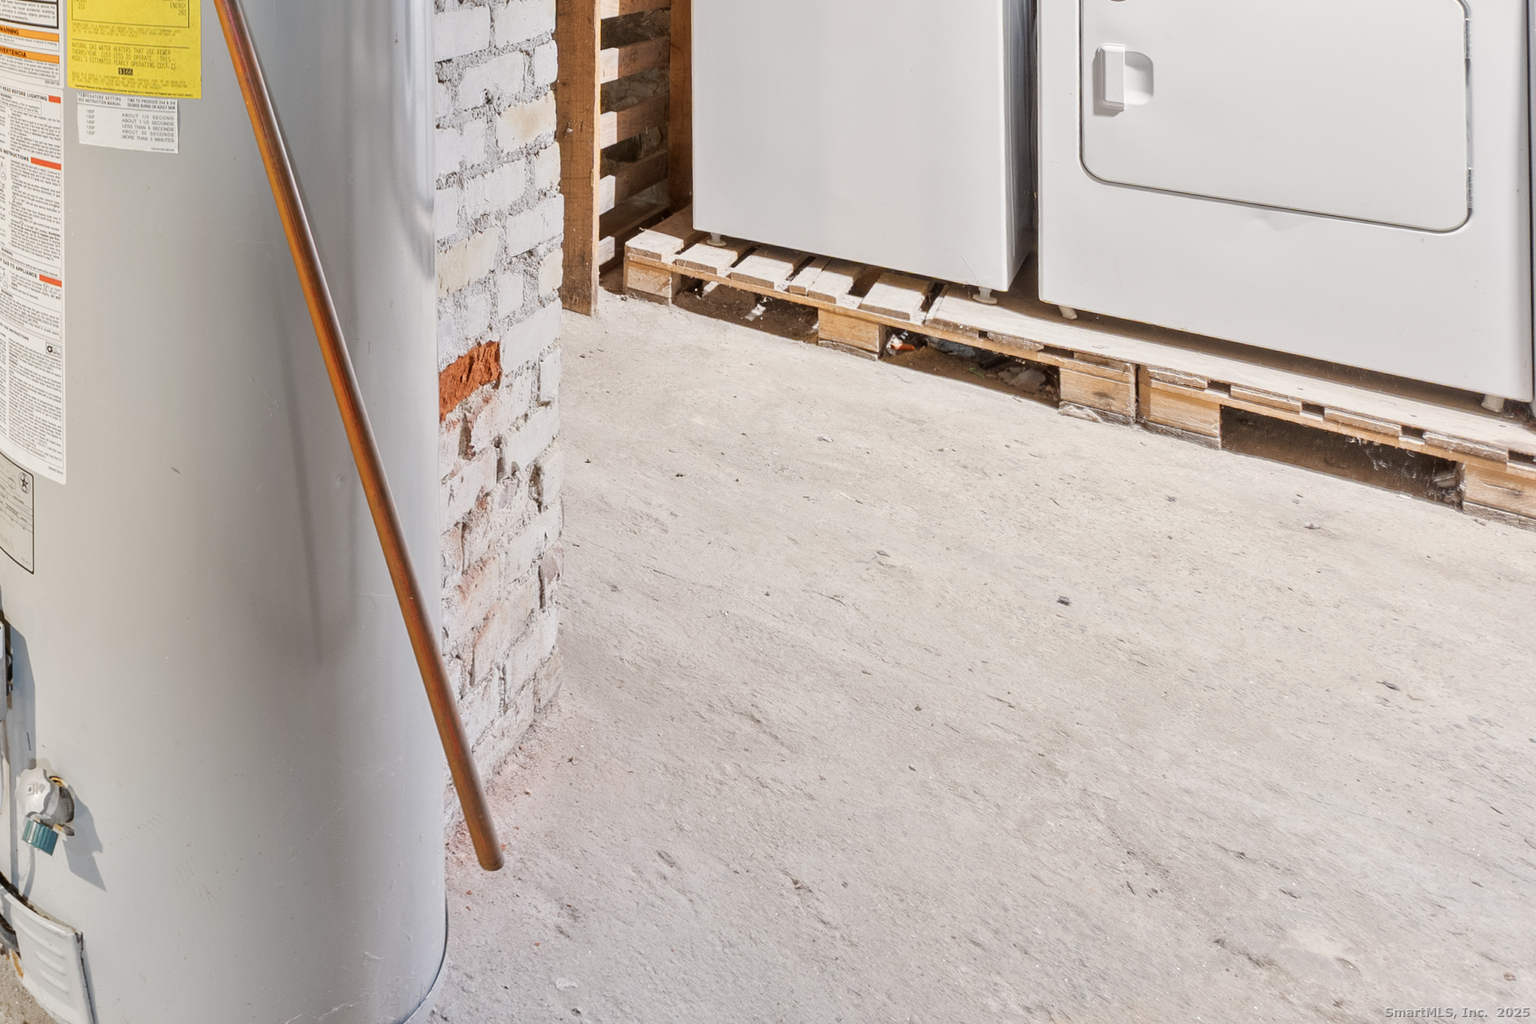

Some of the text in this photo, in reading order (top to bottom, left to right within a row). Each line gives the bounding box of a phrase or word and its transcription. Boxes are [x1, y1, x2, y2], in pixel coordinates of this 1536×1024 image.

[0, 26, 19, 36] WARNING
[89, 57, 111, 65] ESTIMATED
[131, 60, 155, 68] OPERATING
[27, 92, 47, 101] LIGHTING
[3, 149, 29, 162] INSTRUCTIONS
[16, 265, 37, 278] APPLIANCE
